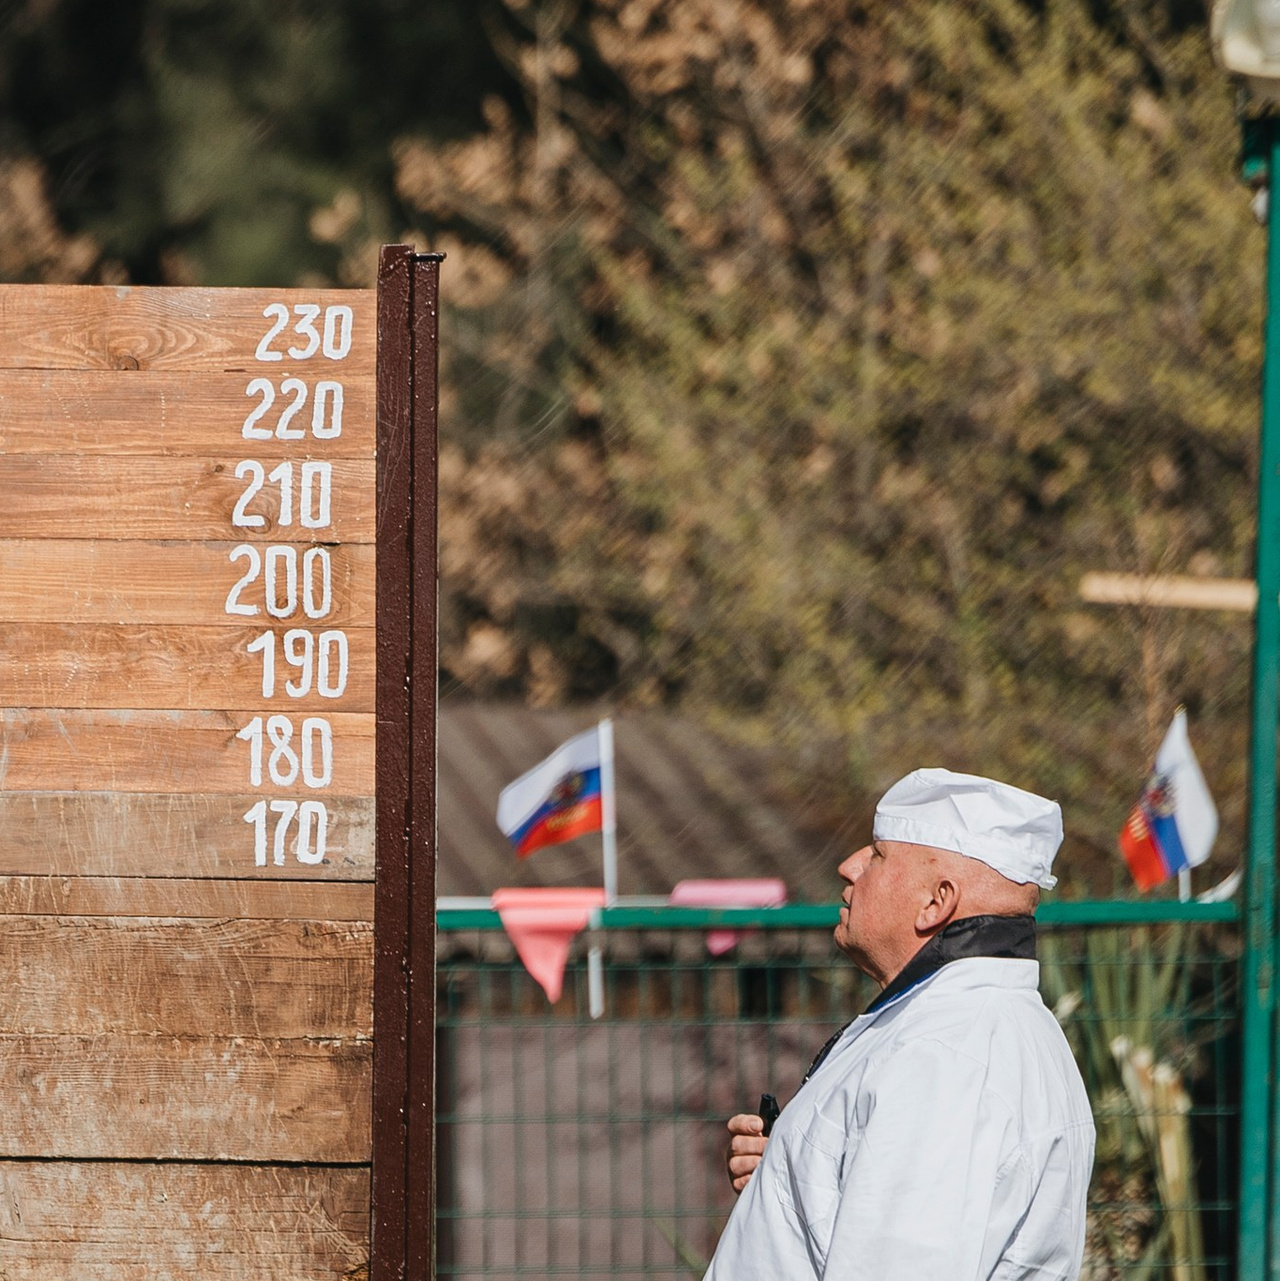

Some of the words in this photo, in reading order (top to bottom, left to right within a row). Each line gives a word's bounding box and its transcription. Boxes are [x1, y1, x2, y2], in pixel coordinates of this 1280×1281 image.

[254, 303, 354, 362] 230
[241, 377, 344, 440] 220
[232, 460, 333, 528] 210
[225, 543, 332, 619] 200
[246, 629, 349, 699] 190
[235, 715, 334, 789] 180
[242, 800, 329, 867] 170
